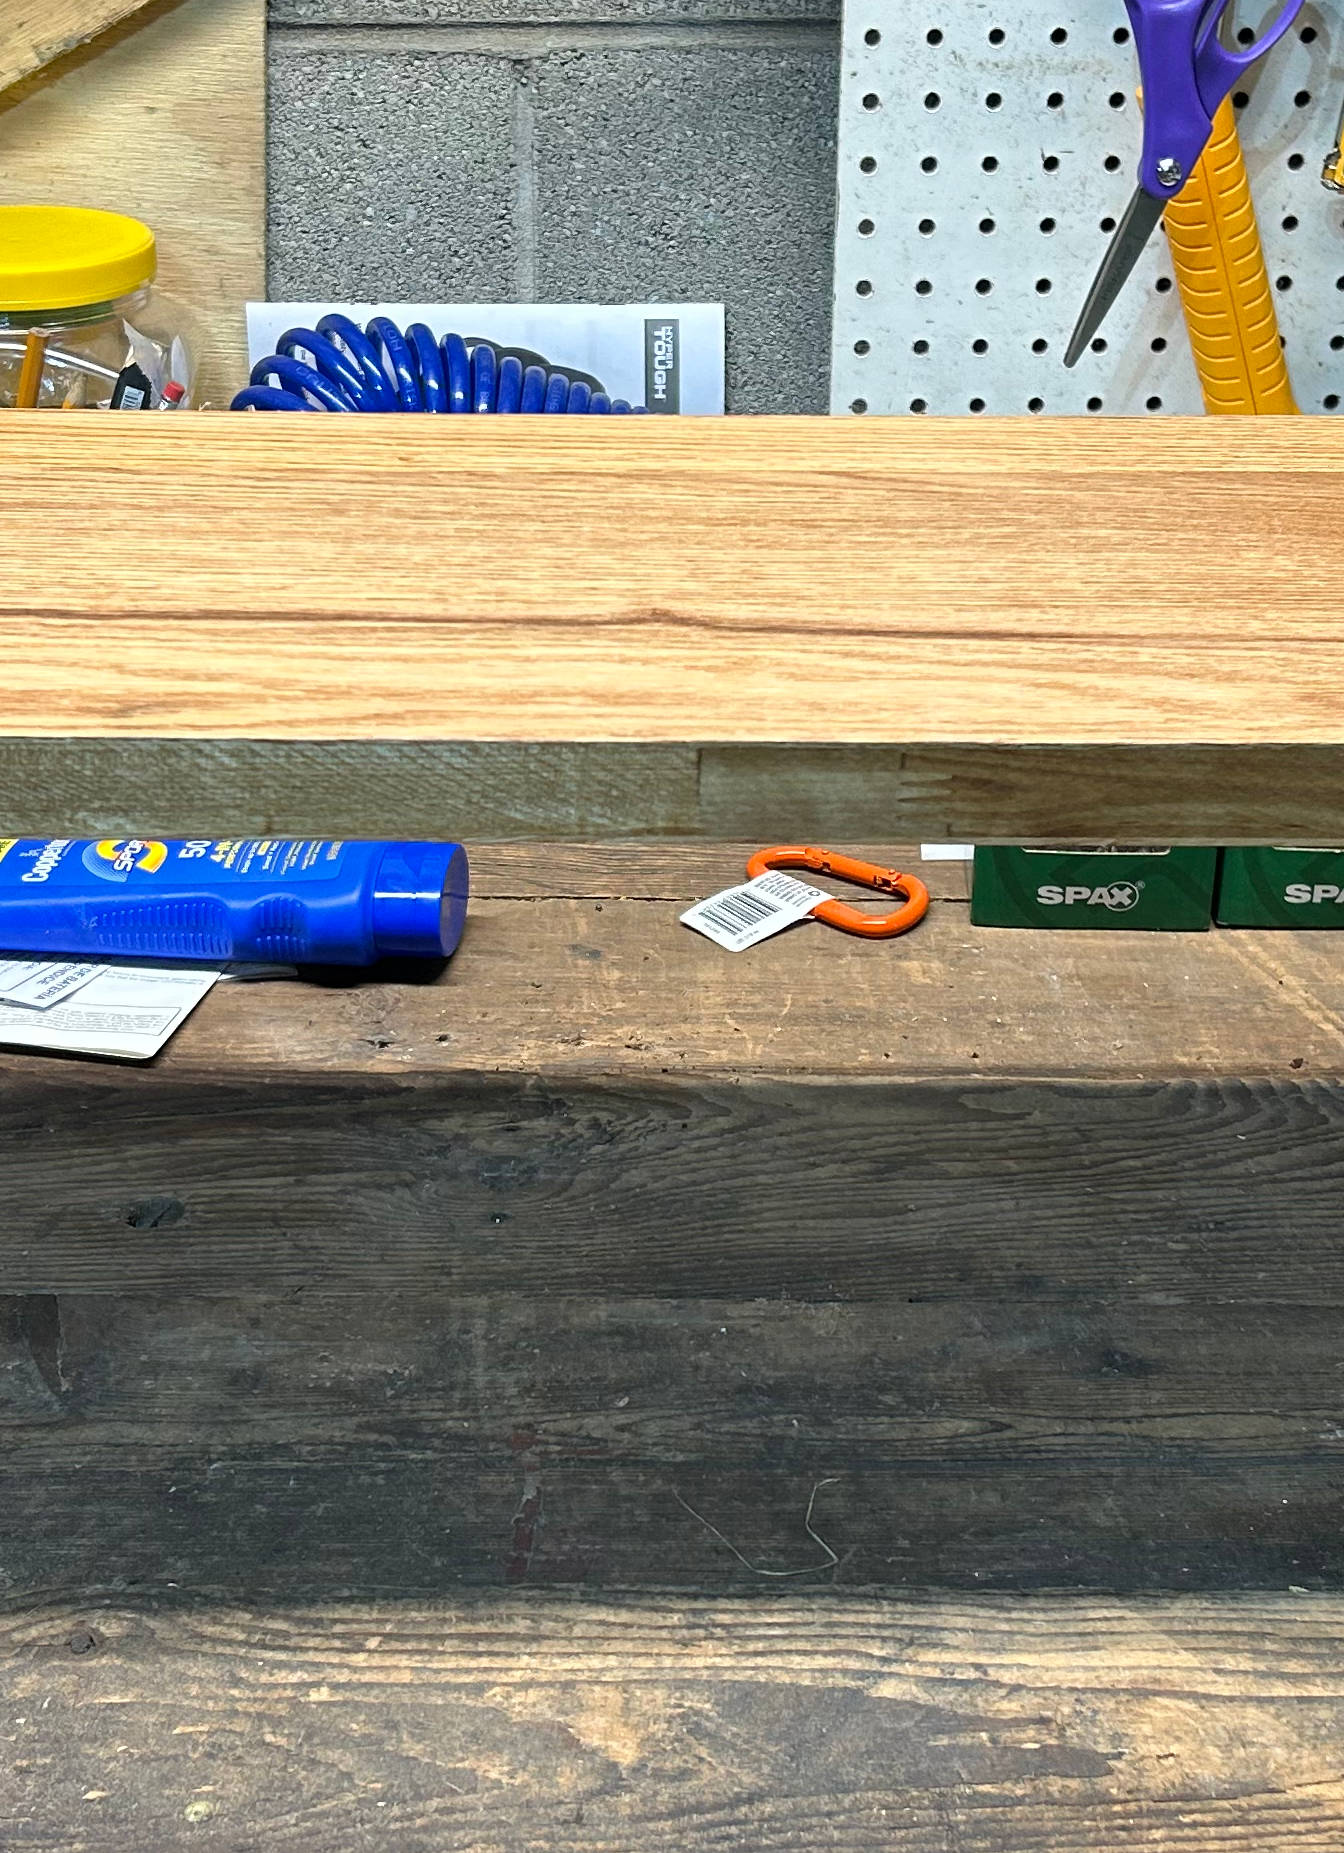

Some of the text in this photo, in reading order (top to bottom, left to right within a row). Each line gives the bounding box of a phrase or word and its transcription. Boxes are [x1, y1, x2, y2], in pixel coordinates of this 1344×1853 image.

[653, 326, 666, 400] TOUGH
[665, 326, 674, 369] HYPER
[178, 840, 212, 859] 50
[1036, 881, 1138, 911] SPAX
